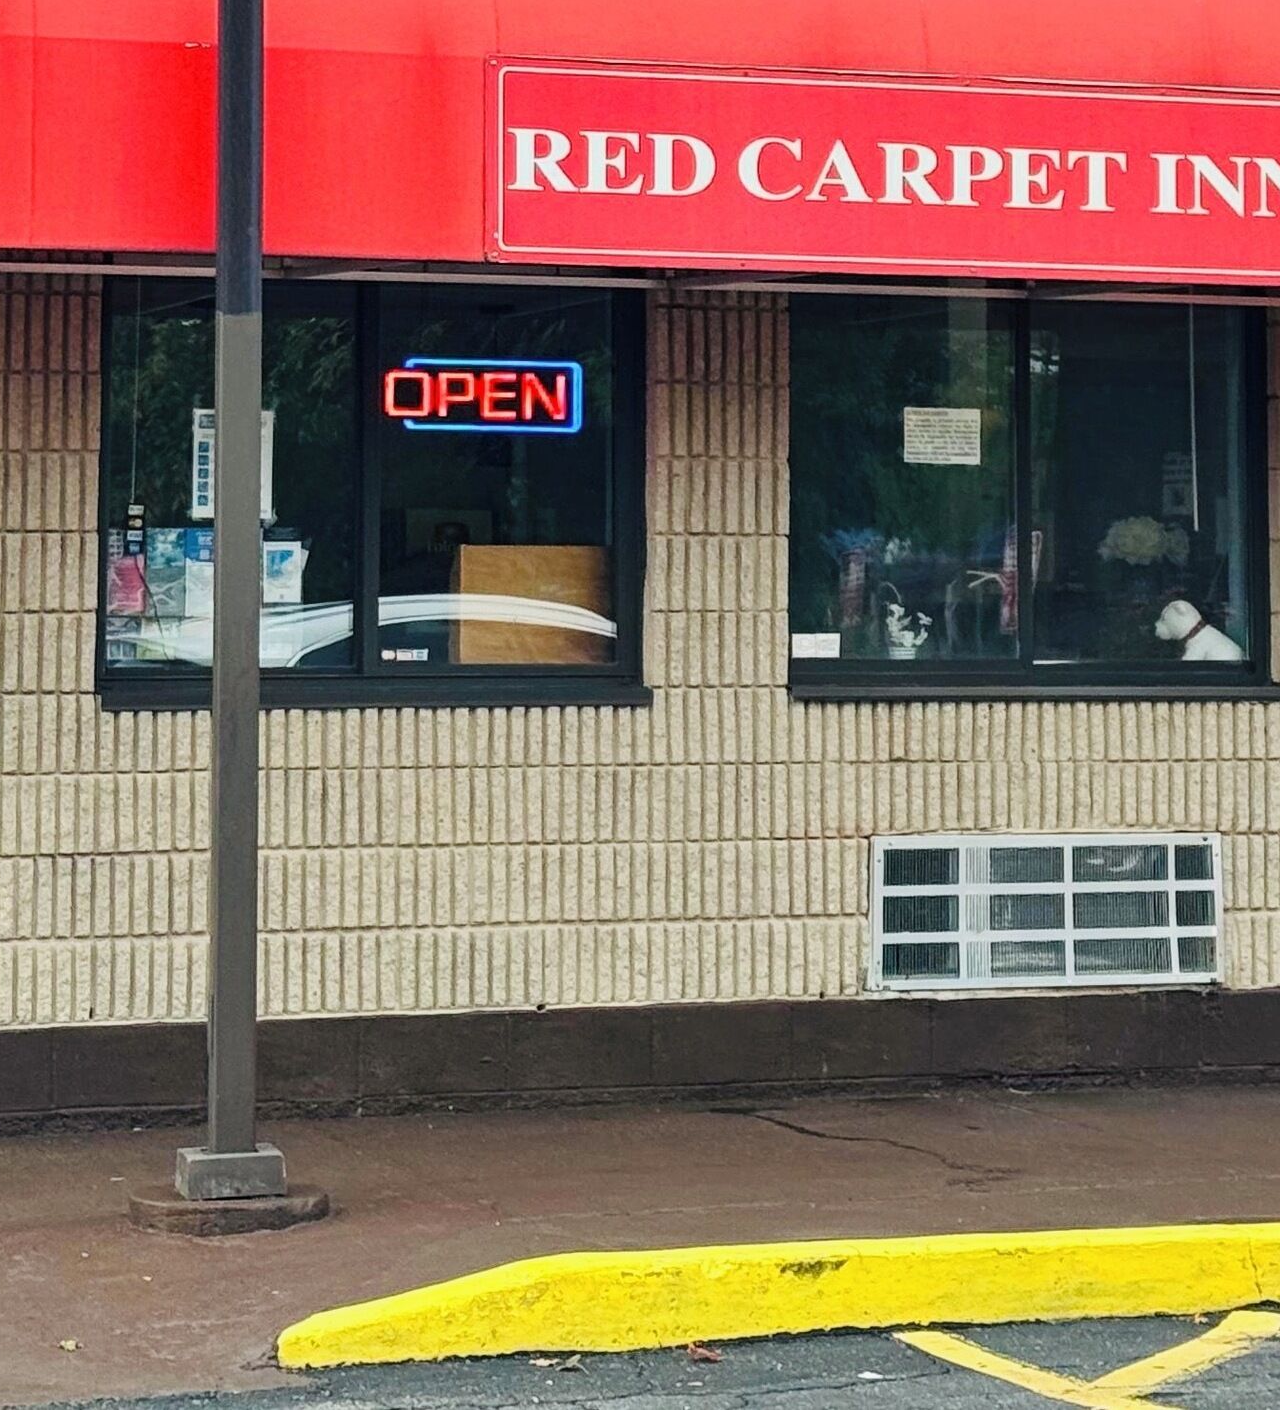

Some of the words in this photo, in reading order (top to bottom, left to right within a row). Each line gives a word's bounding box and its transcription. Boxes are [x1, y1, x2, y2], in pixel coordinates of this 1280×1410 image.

[507, 127, 716, 196] RED
[738, 137, 1127, 211] CARPET
[384, 368, 567, 421] OPEN
